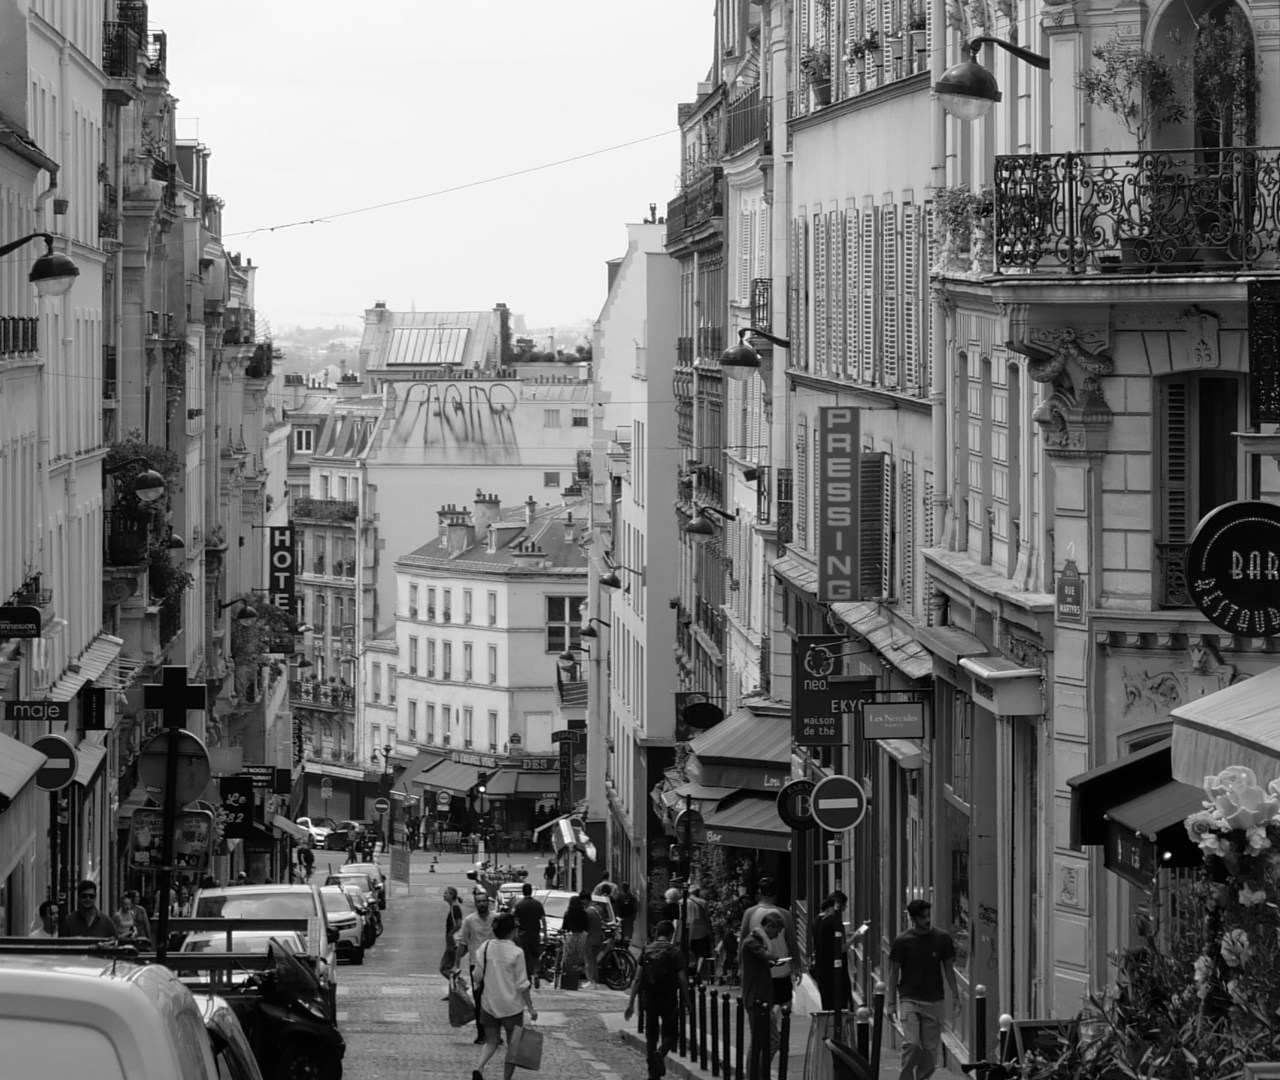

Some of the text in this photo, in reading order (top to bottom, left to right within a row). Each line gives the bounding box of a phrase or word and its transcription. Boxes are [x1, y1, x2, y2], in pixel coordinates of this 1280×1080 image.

[827, 409, 851, 600] PRESSING
[273, 530, 292, 610] HOTE
[1231, 550, 1279, 580] BAR
[1064, 586, 1075, 595] RUE
[1059, 603, 1081, 614] MARTYRS
[13, 703, 60, 720] maje
[831, 699, 873, 713] EKYO
[804, 726, 835, 735] de thé
[522, 759, 547, 769] DES
[795, 794, 812, 816] B
